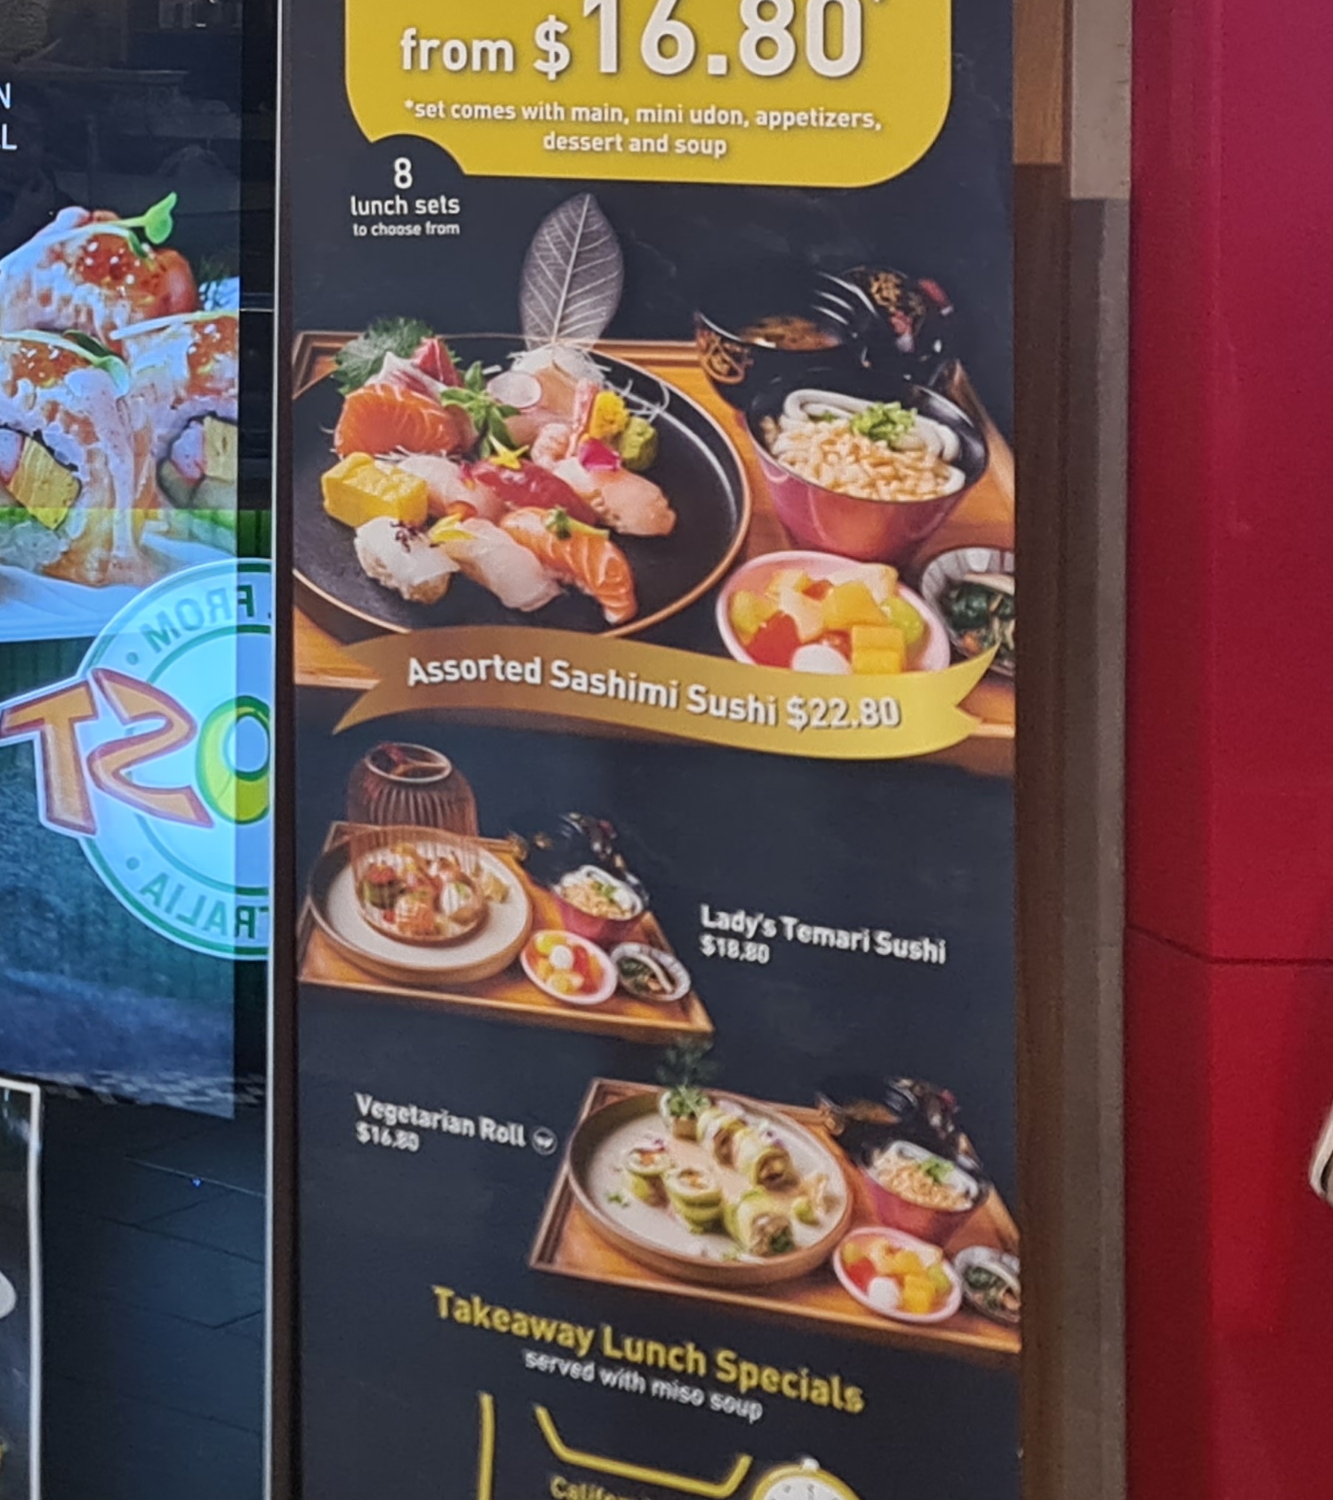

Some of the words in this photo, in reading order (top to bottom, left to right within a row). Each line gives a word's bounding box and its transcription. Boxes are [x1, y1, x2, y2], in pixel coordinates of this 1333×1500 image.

[400, 27, 516, 74] from
[450, 104, 516, 120] comes
[521, 103, 565, 121] with
[571, 104, 629, 125] main,
[636, 104, 683, 124] mini
[689, 105, 750, 128] udon,
[755, 108, 882, 132] appetizers,
[543, 132, 623, 153] dessert
[629, 133, 669, 153] and
[674, 138, 728, 158] soup
[394, 157, 413, 189] 8
[351, 194, 409, 216] lunch
[415, 194, 460, 214] sets
[353, 223, 367, 237] to
[371, 222, 422, 237] choose
[425, 220, 460, 236] from
[408, 656, 541, 686] Assorted
[549, 660, 678, 709] Sashimi
[686, 685, 777, 726] Sushi
[786, 696, 902, 731] $22.80
[700, 903, 777, 939] Lady's
[780, 915, 871, 952] Temari
[874, 929, 947, 964] Sushi
[354, 1092, 476, 1138] Vegetarian
[479, 1116, 527, 1148] Roll
[432, 1285, 595, 1357] Takeaway
[602, 1323, 707, 1378] Lunch
[715, 1349, 866, 1414] Specials
[523, 1349, 595, 1382] served
[599, 1367, 647, 1395] with
[651, 1378, 704, 1407] miso
[709, 1393, 764, 1424] soup
